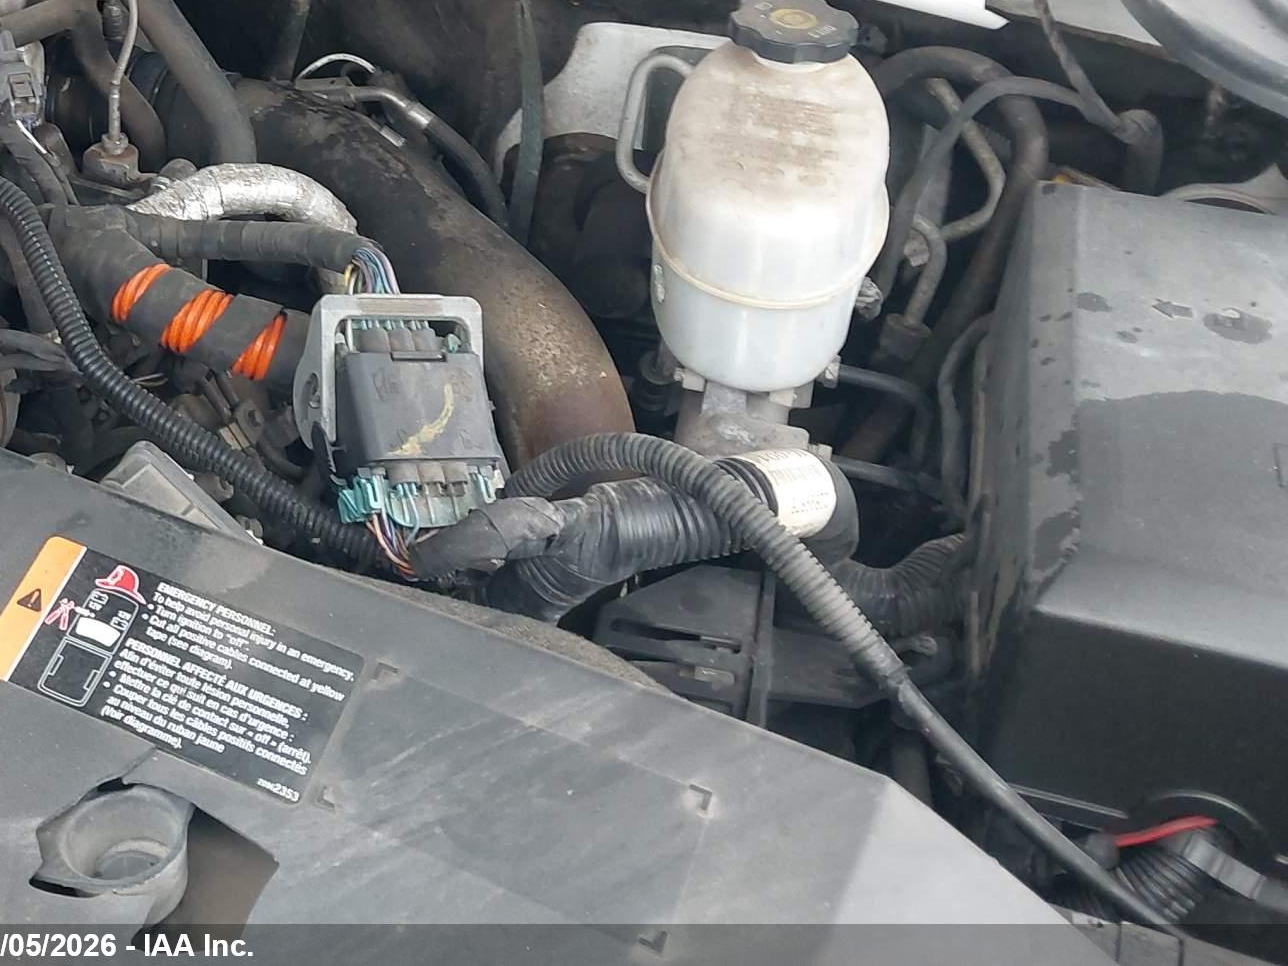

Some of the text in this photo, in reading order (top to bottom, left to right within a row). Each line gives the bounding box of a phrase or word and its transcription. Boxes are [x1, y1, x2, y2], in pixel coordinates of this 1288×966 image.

[154, 605, 177, 619] Turn
[176, 614, 213, 634] ignition
[157, 582, 277, 635] EMERGENCY PERSONNEL:
[164, 597, 185, 612] help
[184, 606, 209, 620] avoid
[209, 616, 250, 636] personal
[299, 653, 356, 681] emergency,
[125, 638, 183, 667] PERSONNEL
[181, 660, 227, 685] AFFECTÉ
[224, 679, 248, 695] AUX
[246, 688, 303, 718] URGENCES
[145, 626, 235, 669] tape (see diagram).
[149, 615, 167, 627] Cut
[166, 622, 179, 632] all
[178, 628, 217, 648] positive
[216, 643, 248, 661] cables
[247, 657, 300, 682] connected
[309, 681, 345, 702] yellow
[115, 659, 157, 682] effectuer
[186, 689, 206, 703] suit
[219, 705, 239, 717] cas
[237, 711, 290, 740] d'urgence
[119, 673, 152, 692] Mettre
[161, 691, 178, 704] clé
[191, 705, 229, 726] contact
[228, 722, 246, 734] sur
[254, 731, 270, 744] off
[120, 649, 291, 727] Afin d'éviter toute lésion personnelle,
[100, 704, 184, 749] (Voir diagramme).
[112, 684, 308, 775] Couper tous les câbles positifs connectés
[119, 699, 154, 720] niveau
[166, 720, 197, 739] ruban
[194, 733, 226, 754] jaune
